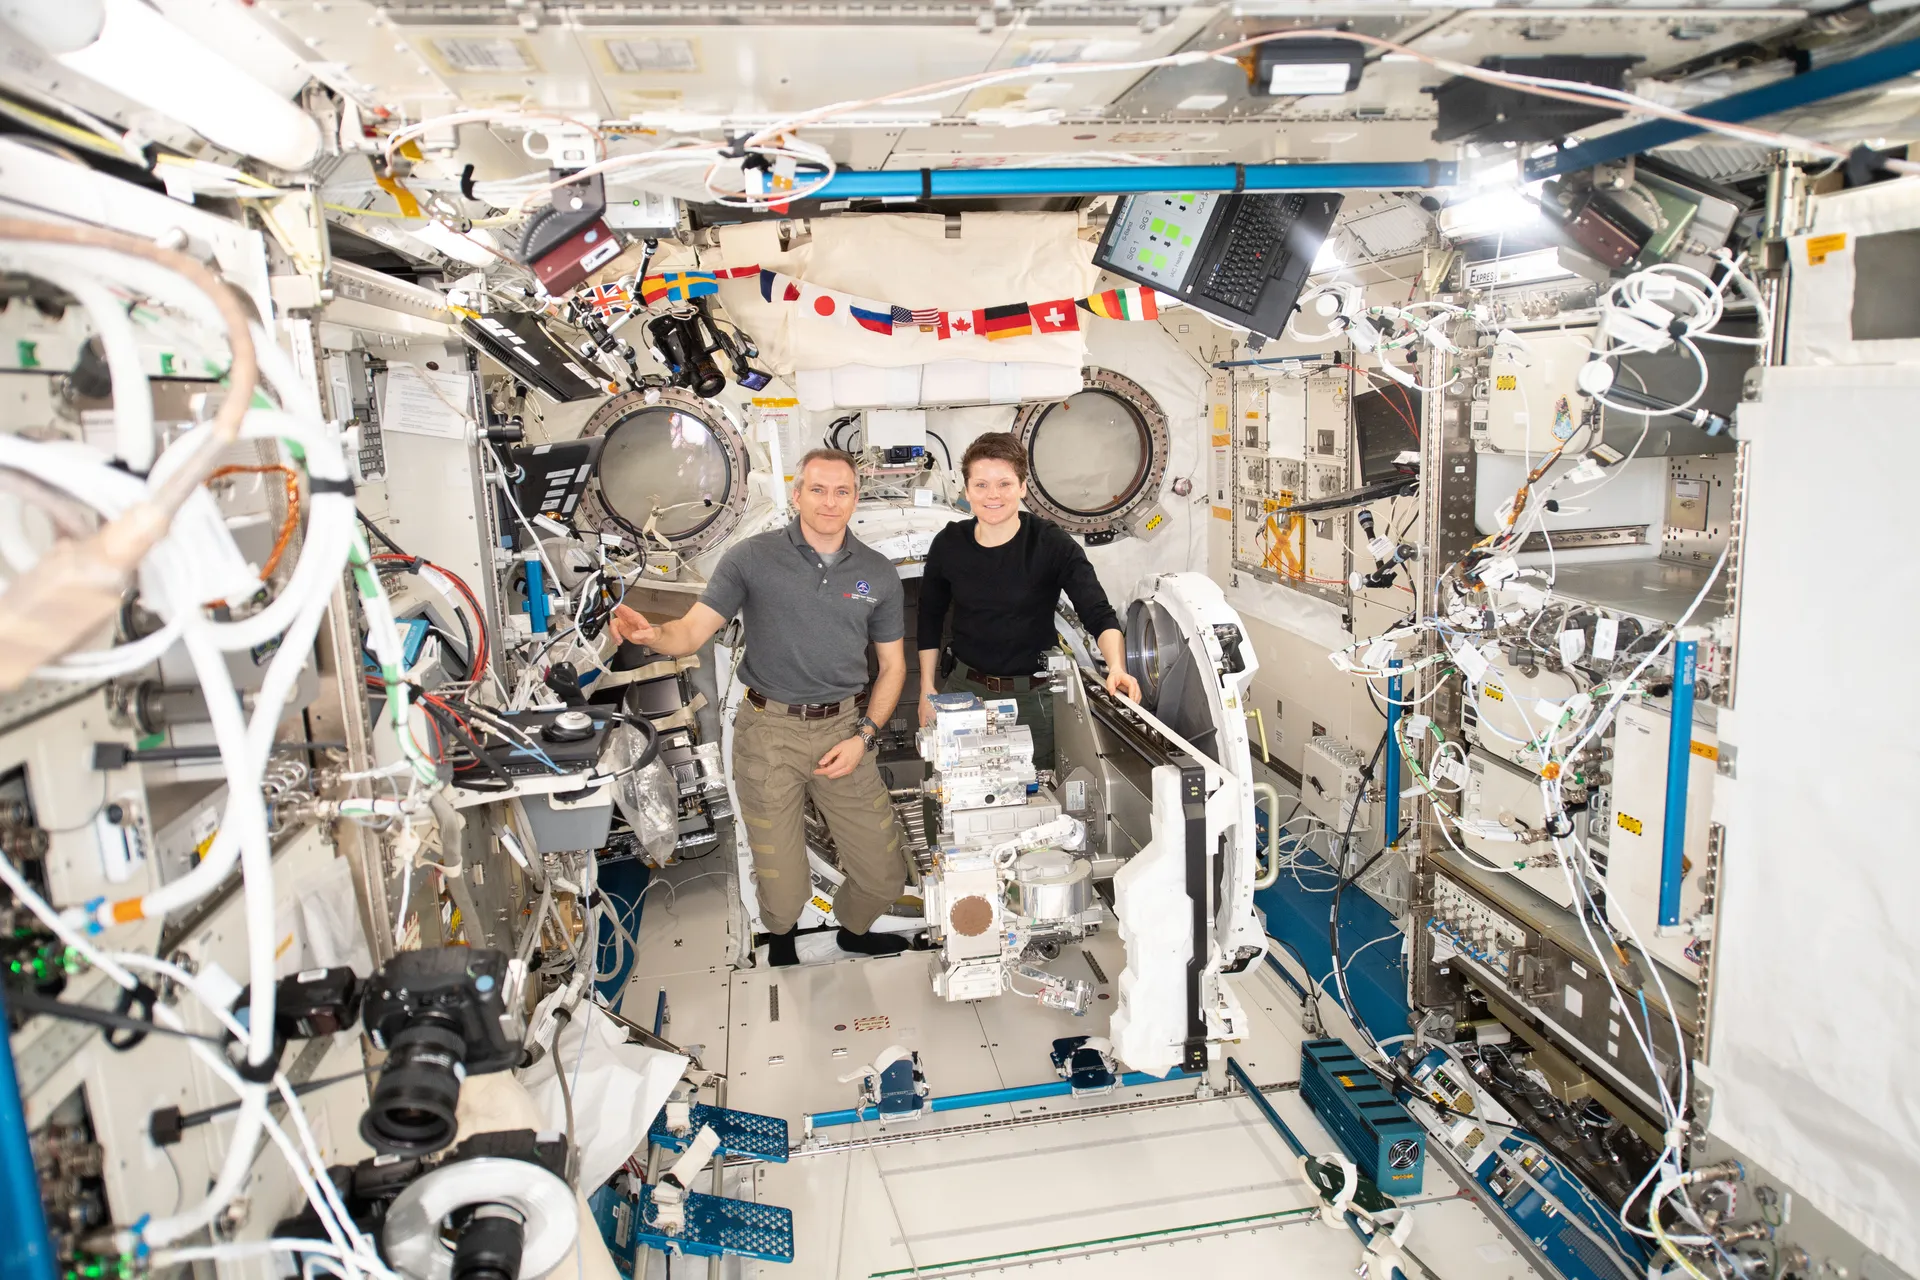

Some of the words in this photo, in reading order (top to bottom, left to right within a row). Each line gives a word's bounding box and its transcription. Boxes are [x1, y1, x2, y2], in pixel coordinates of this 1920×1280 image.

[1197, 201, 1205, 215] OCA
[1139, 216, 1149, 231] S/G
[1127, 246, 1137, 261] S/G
[1174, 250, 1185, 267] Health
